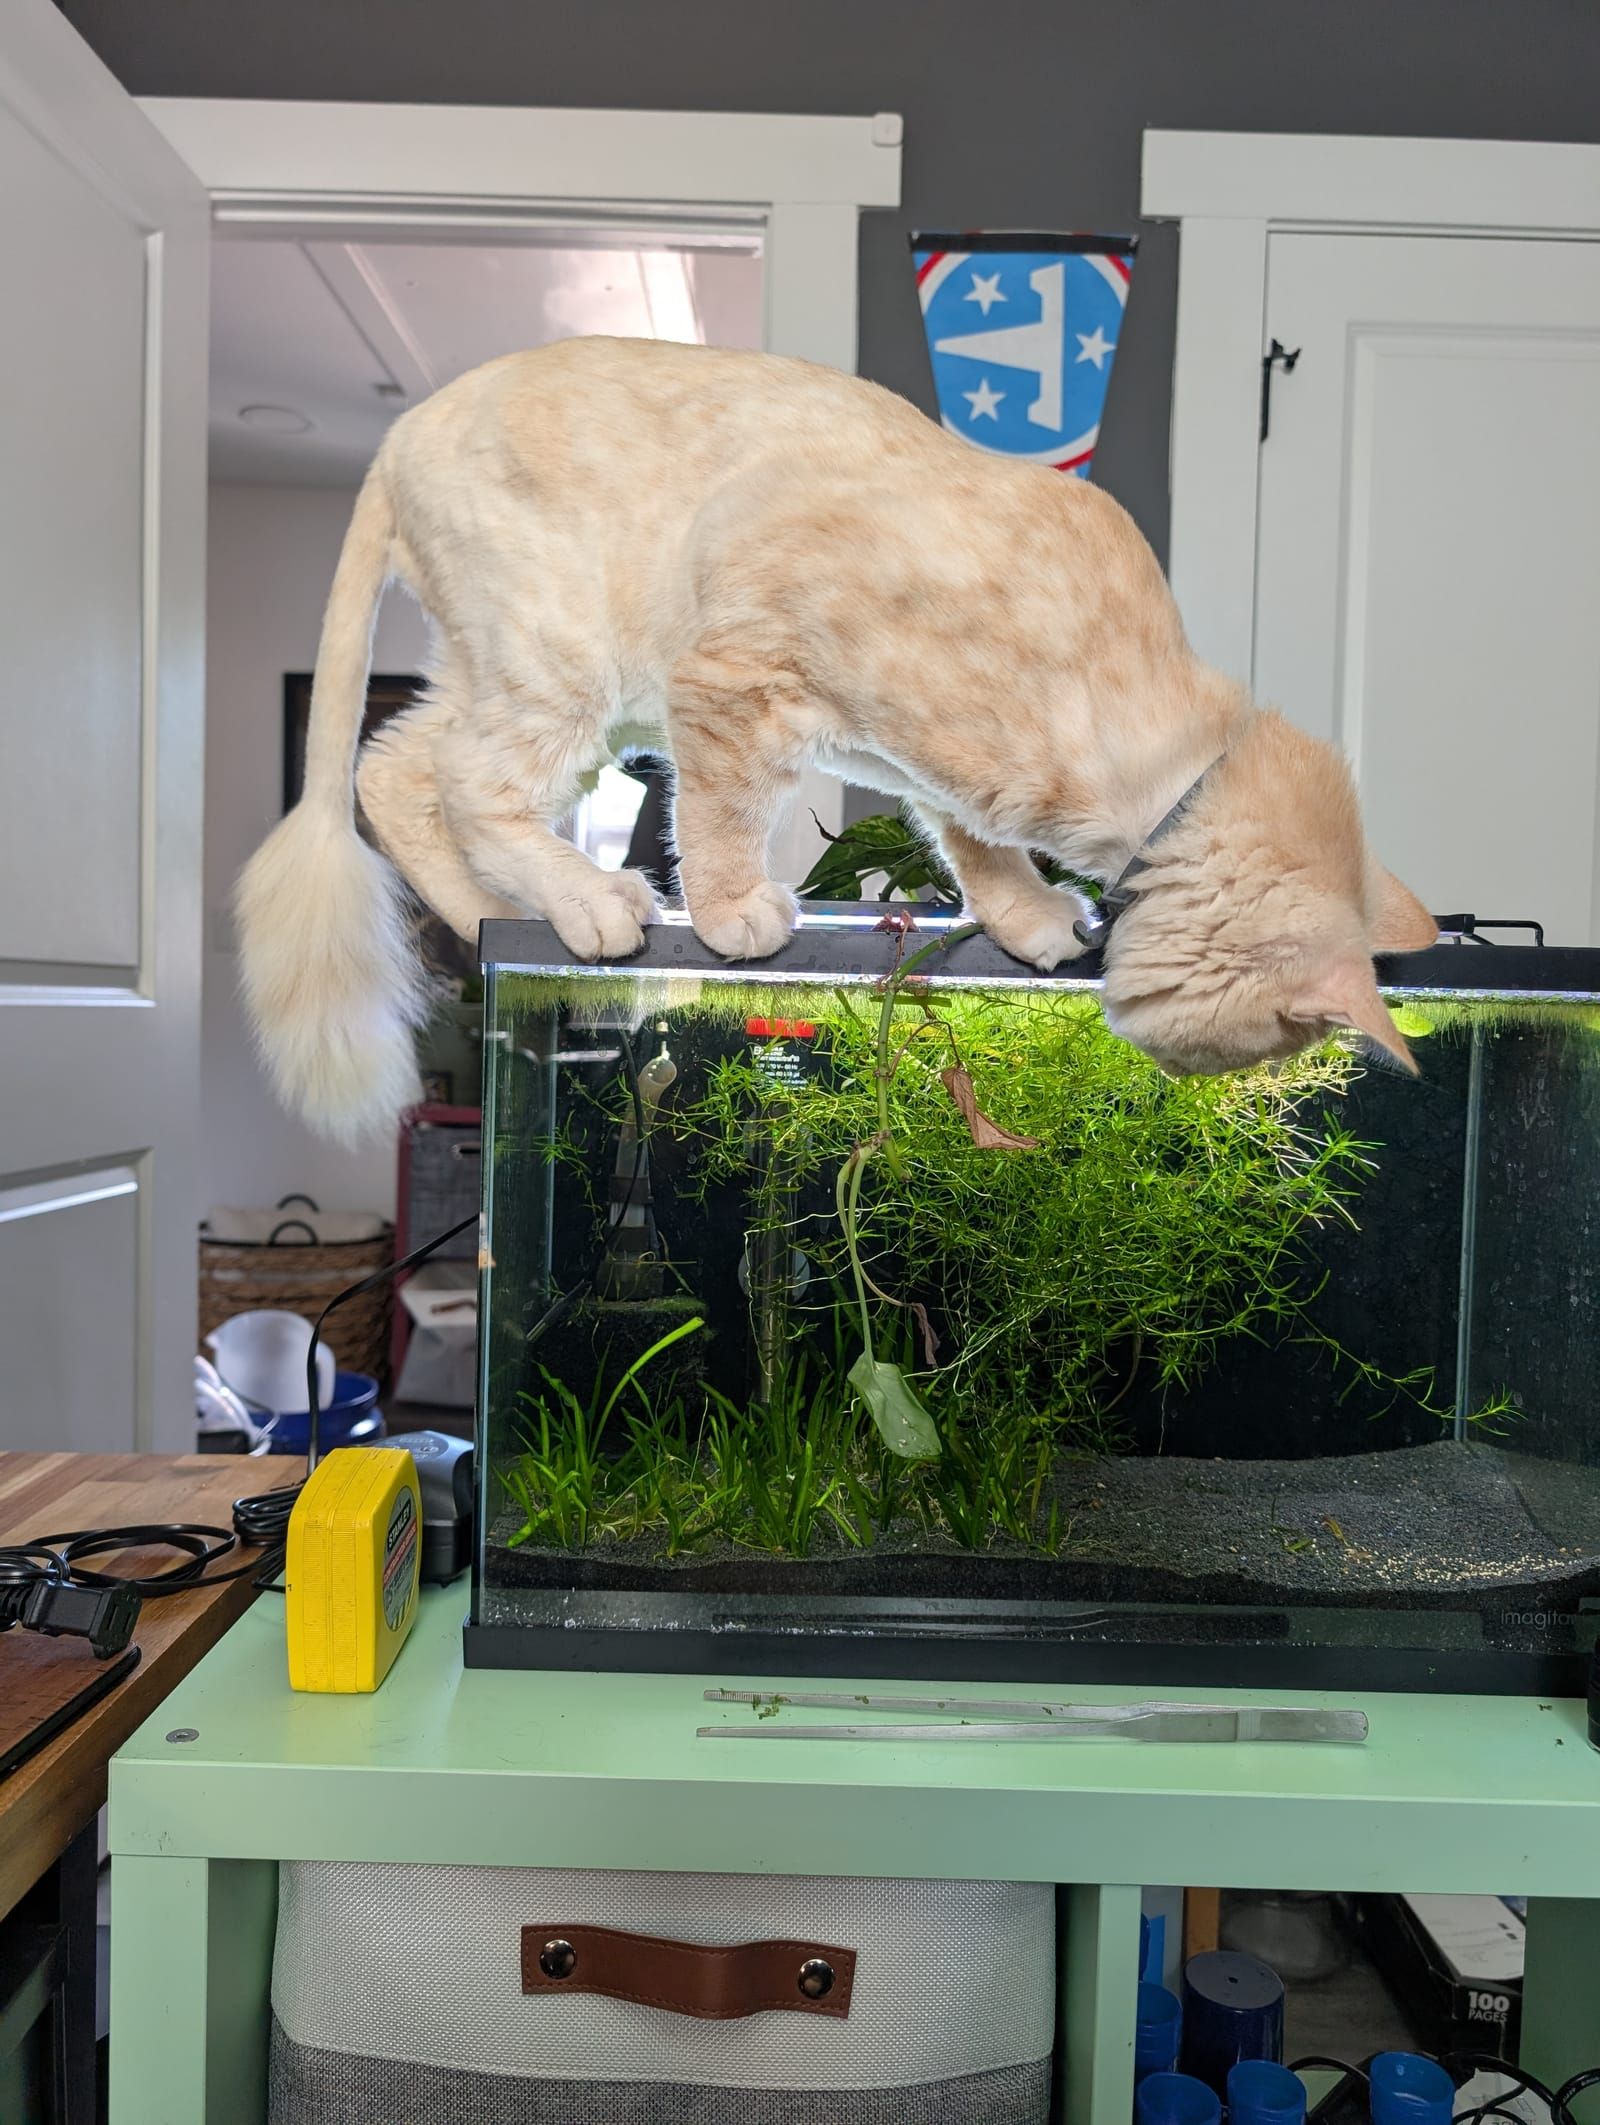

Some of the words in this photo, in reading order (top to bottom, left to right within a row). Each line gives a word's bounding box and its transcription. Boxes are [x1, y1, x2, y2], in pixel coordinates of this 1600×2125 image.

[389, 1502, 411, 1549] STANLEY
[1468, 1991, 1510, 2011] 100
[1468, 2010, 1508, 2023] PAGES
